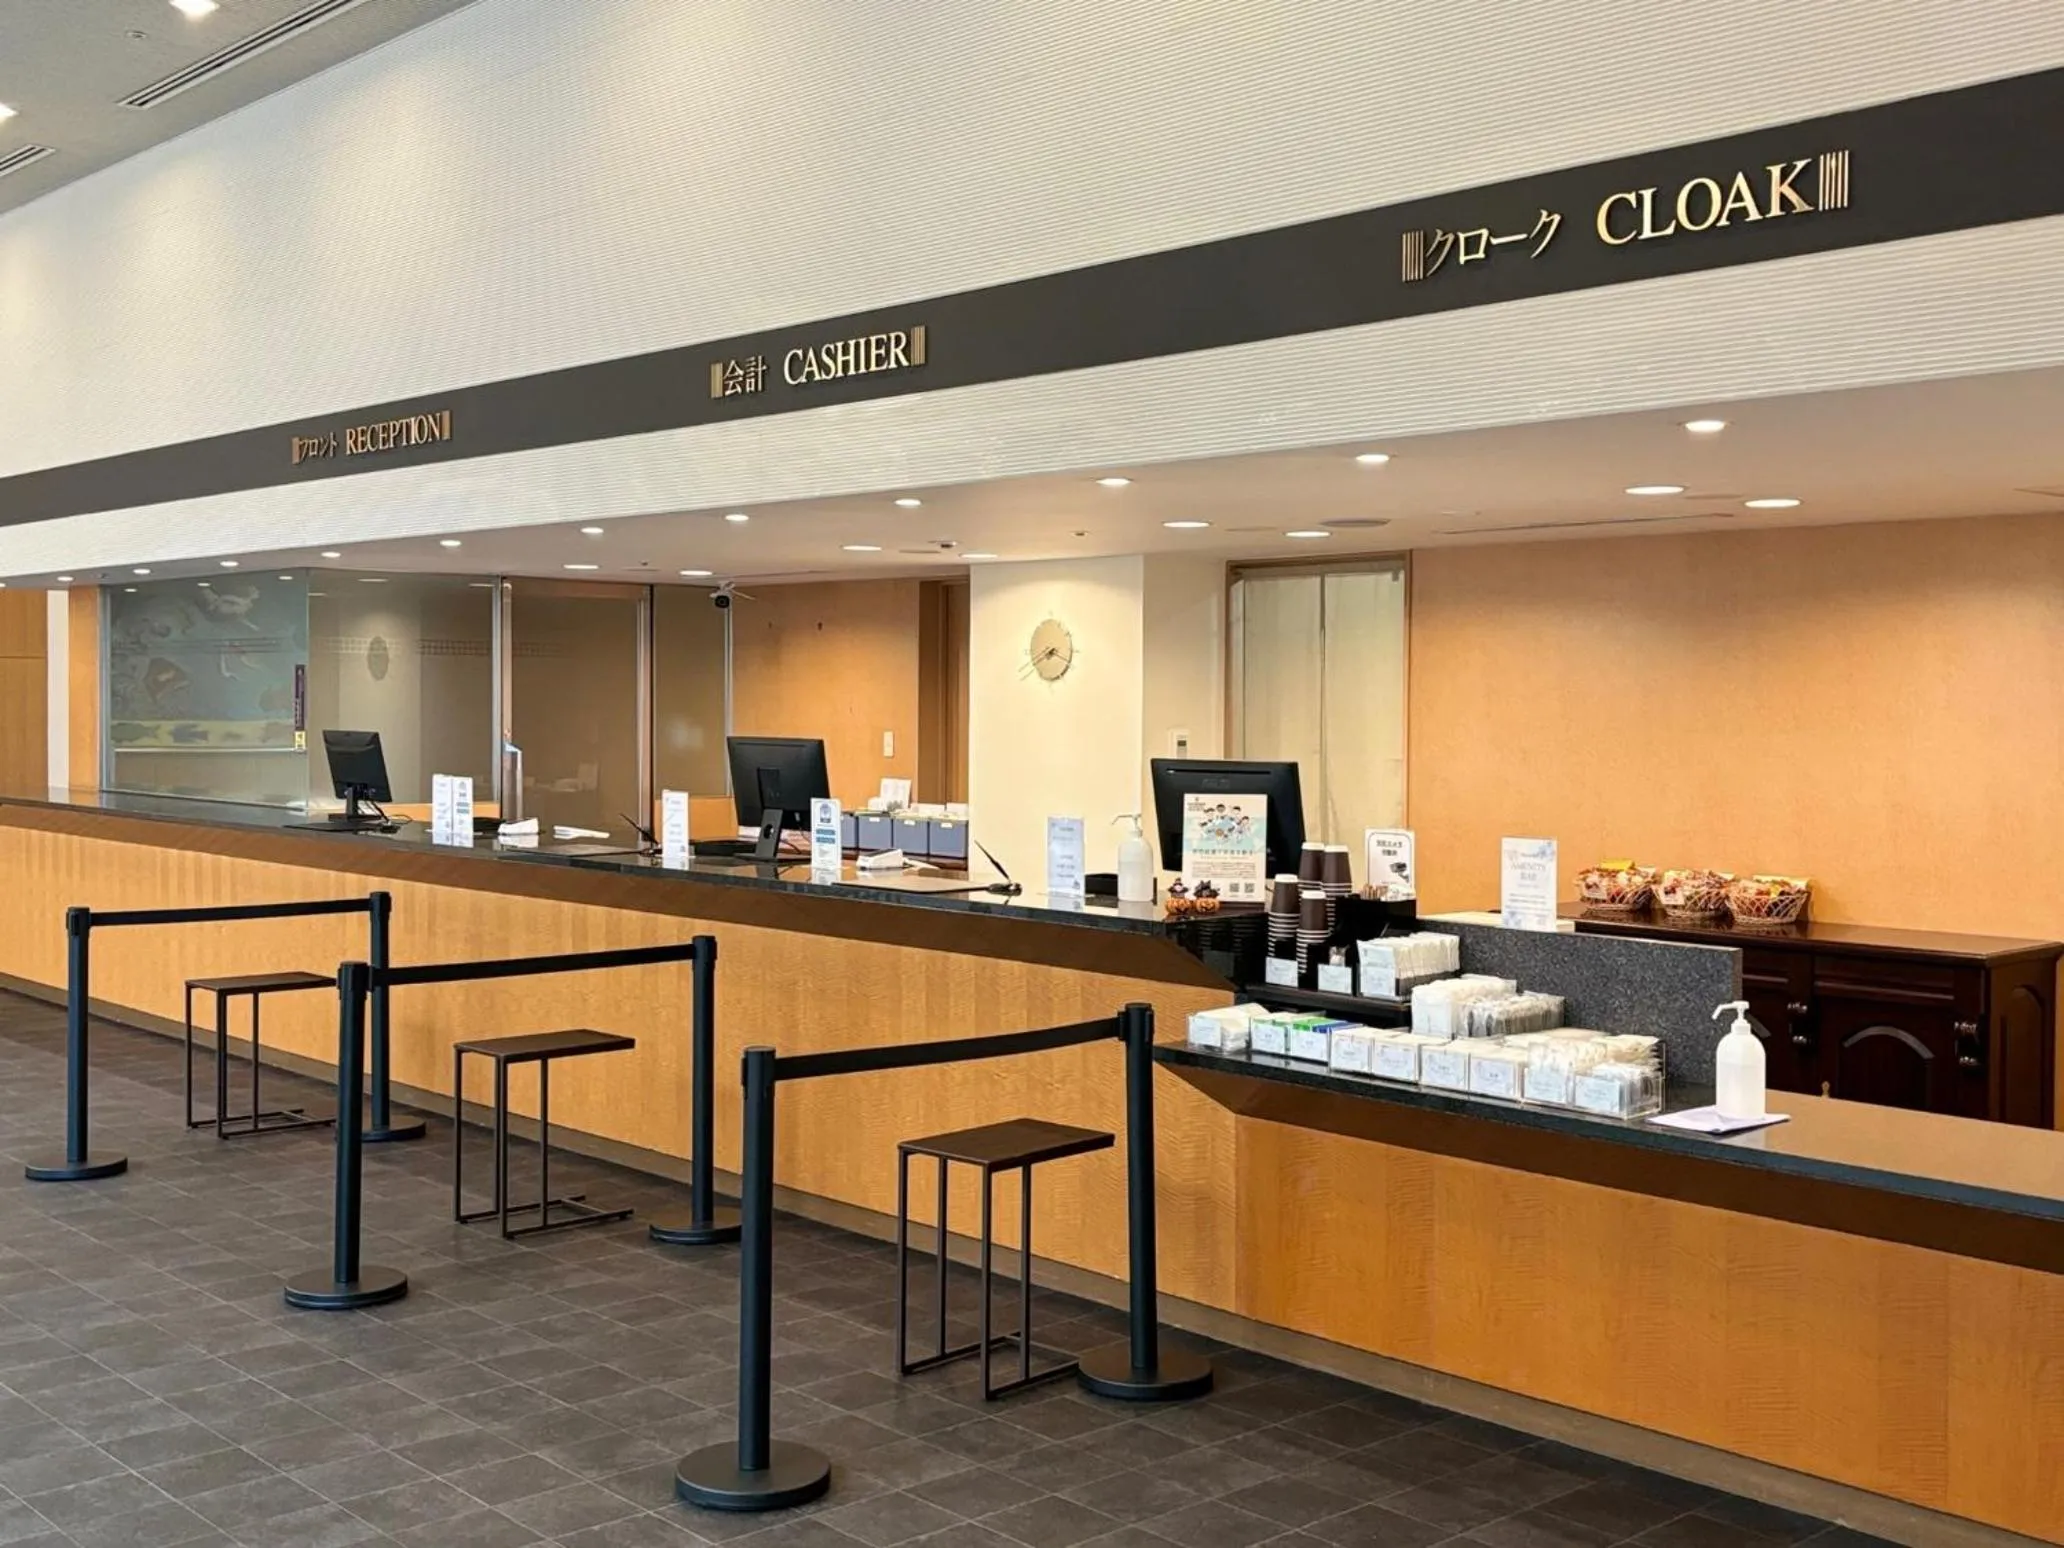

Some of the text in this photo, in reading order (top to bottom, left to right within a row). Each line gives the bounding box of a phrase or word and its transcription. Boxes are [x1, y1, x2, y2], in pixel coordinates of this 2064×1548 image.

[1425, 159, 1813, 276] クローク CLOAK
[723, 331, 909, 396] 会計 CASHIER
[299, 412, 441, 461] フロント RECEPTION
